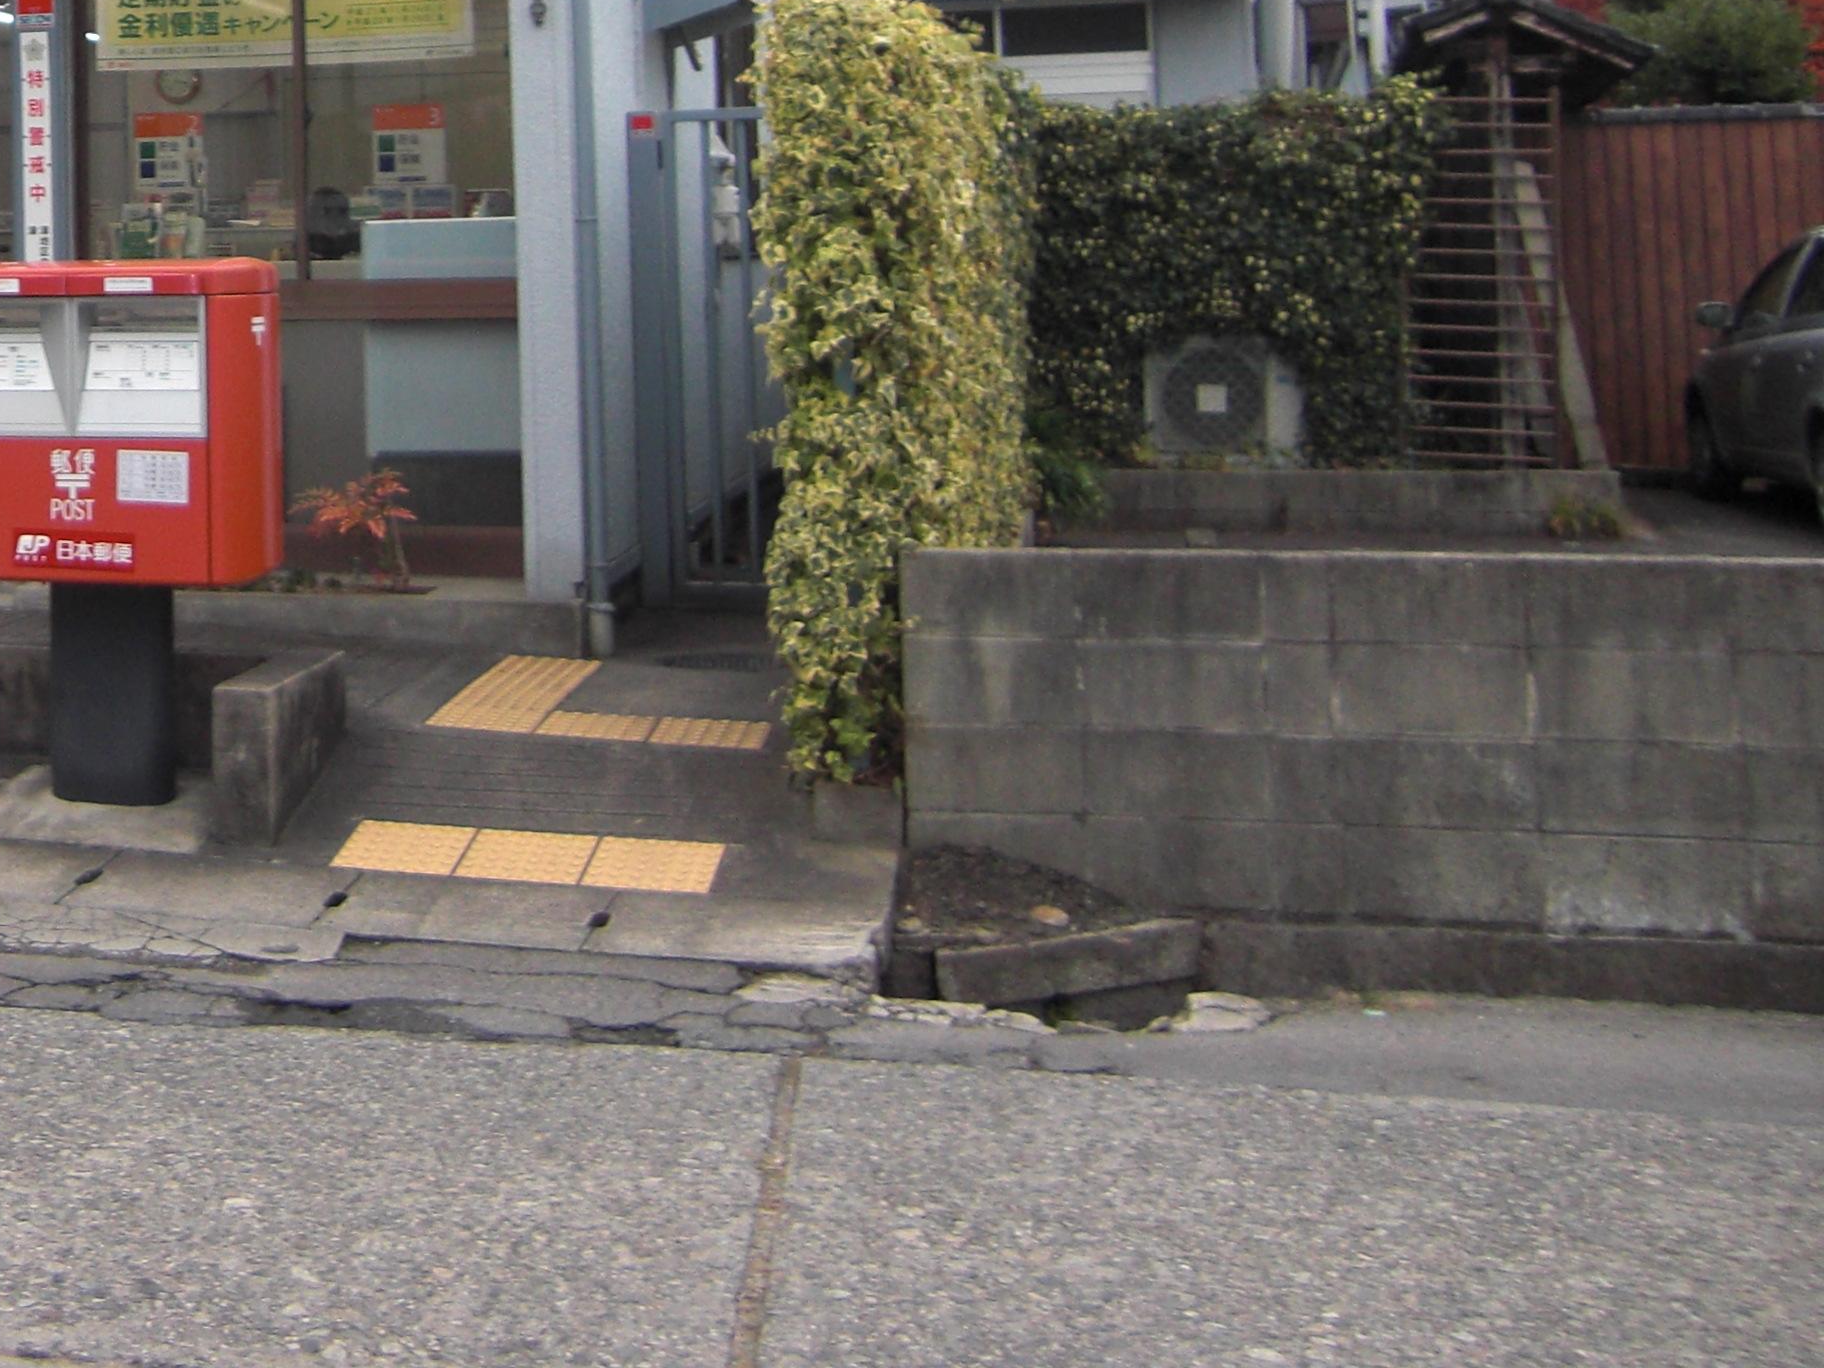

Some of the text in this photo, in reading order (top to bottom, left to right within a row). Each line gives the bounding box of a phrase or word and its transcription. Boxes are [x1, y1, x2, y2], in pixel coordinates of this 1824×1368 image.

[27, 69, 46, 202] 特別警戒中
[50, 448, 96, 475] 郵便
[50, 498, 96, 521] POST
[55, 539, 132, 564] 日本郵便
